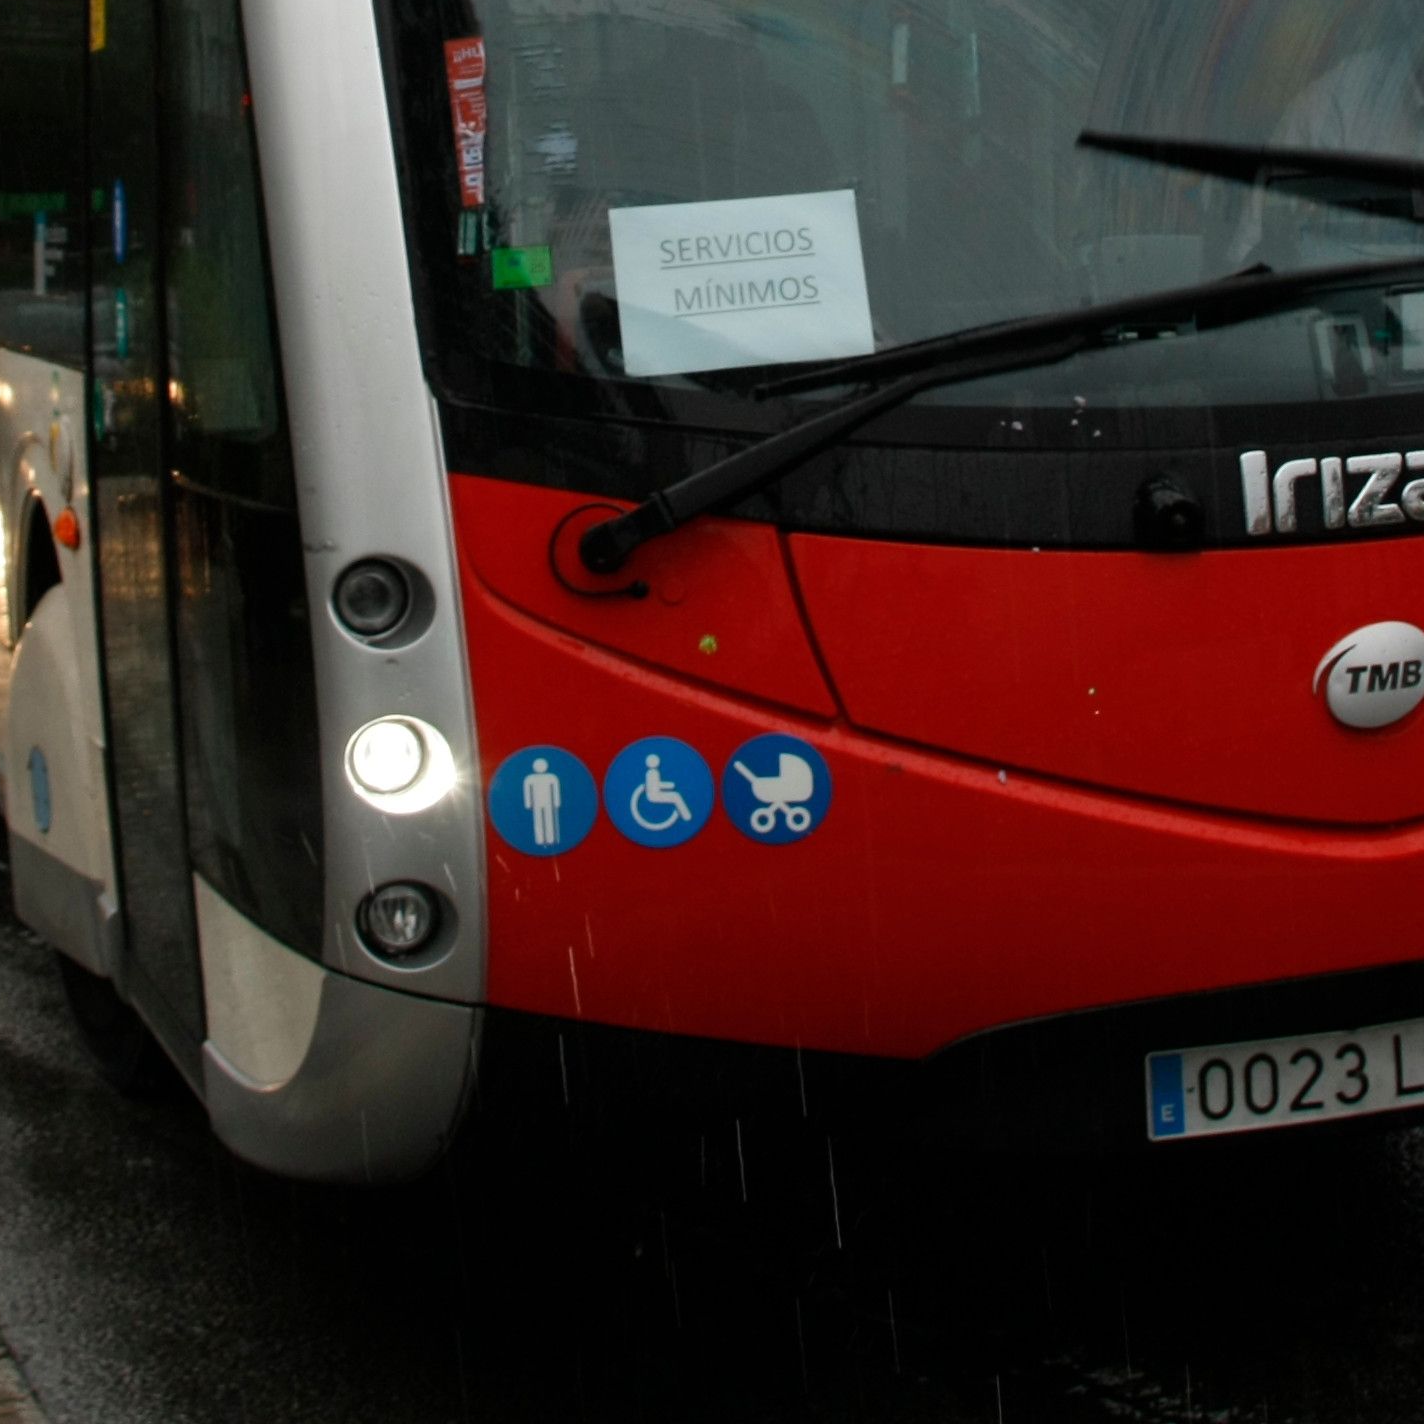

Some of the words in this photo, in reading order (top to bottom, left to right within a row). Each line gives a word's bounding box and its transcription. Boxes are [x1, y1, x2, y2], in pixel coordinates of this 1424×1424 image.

[659, 227, 814, 265] SERVICIOS
[673, 275, 819, 313] MÍNIMOS
[1346, 659, 1422, 695] TMB
[1198, 1044, 1369, 1121] 0023
